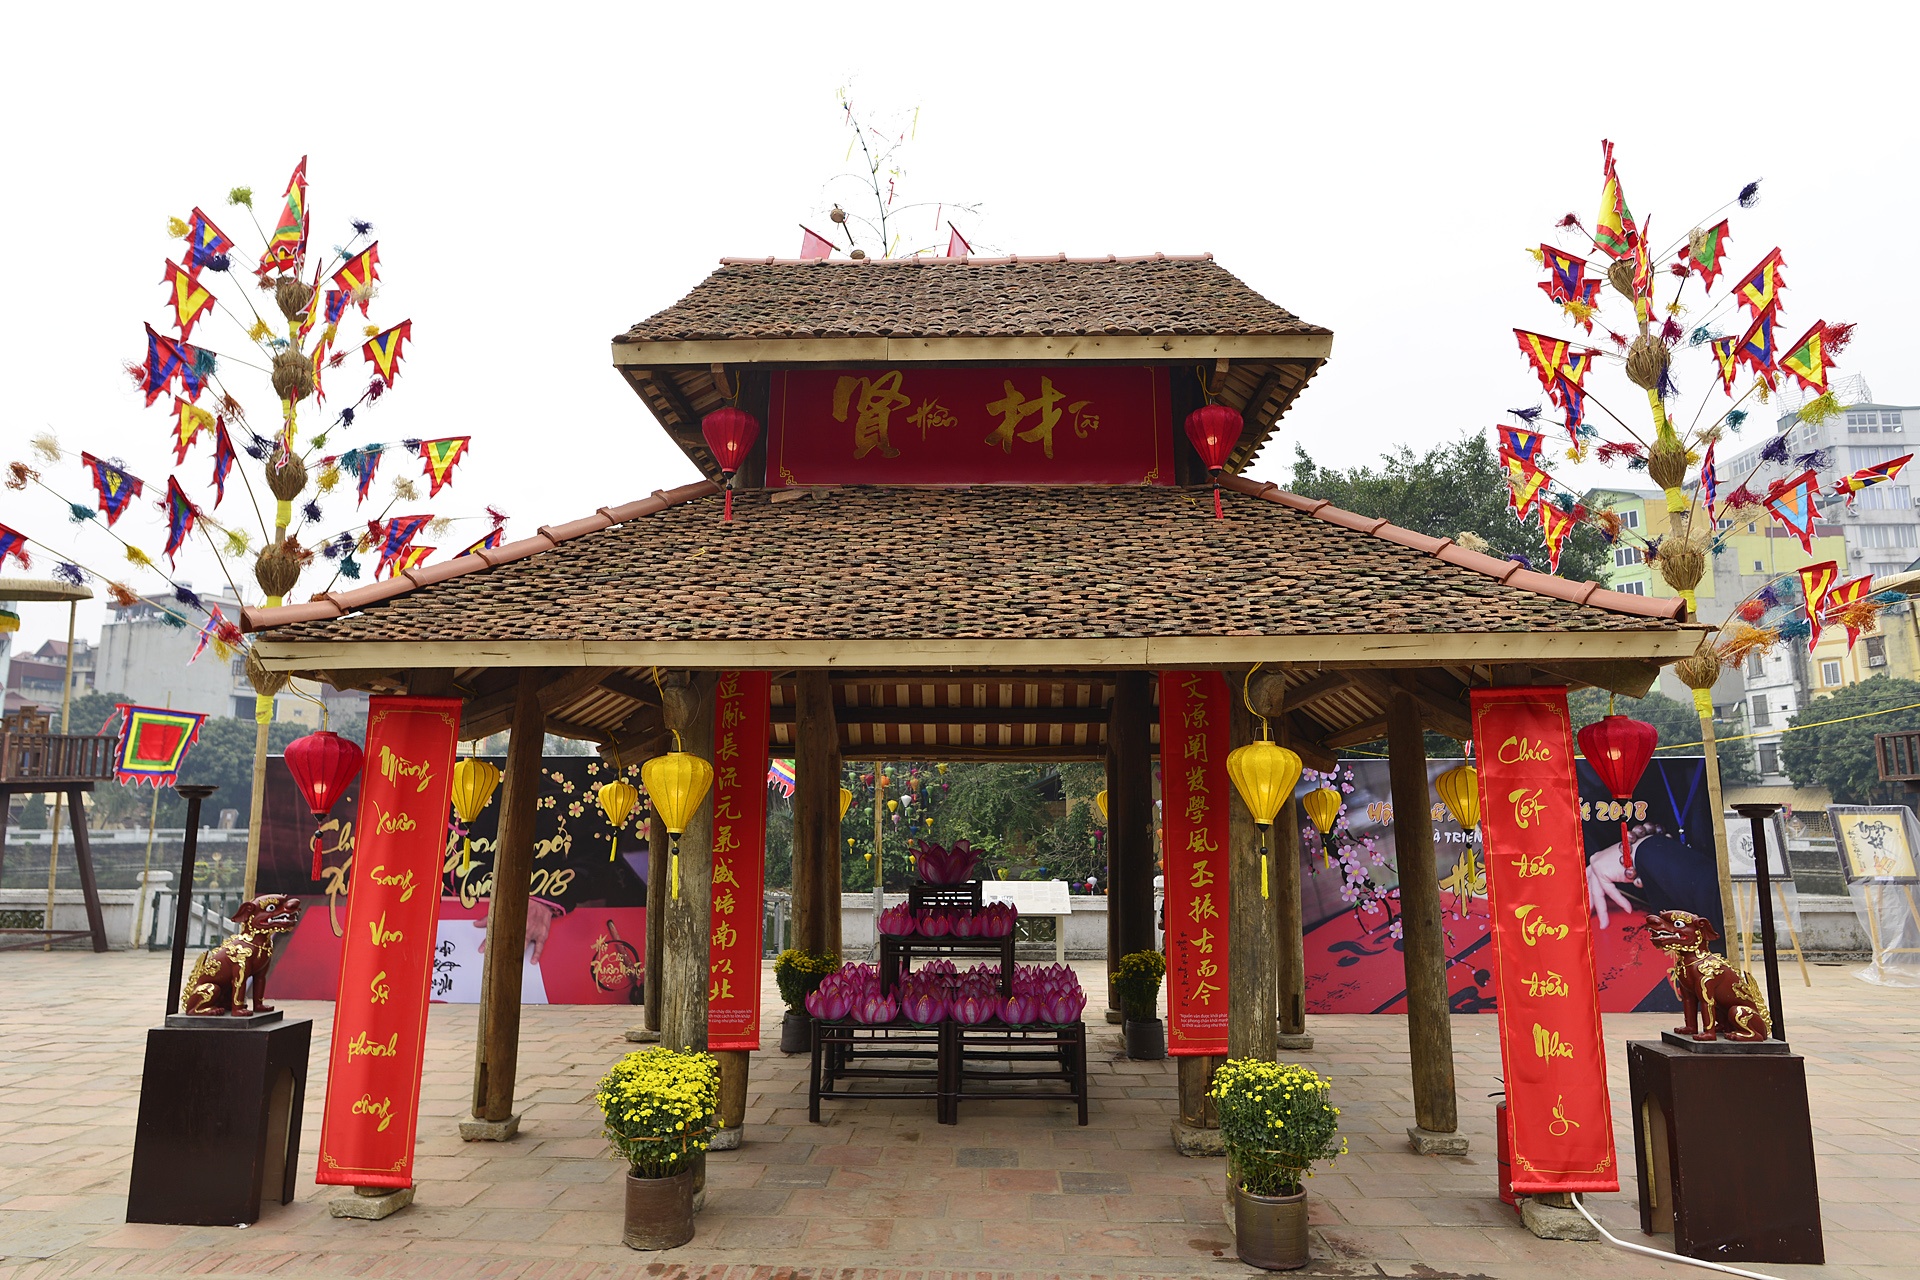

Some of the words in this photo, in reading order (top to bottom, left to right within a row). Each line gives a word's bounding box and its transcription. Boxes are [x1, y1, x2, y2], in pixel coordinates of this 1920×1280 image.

[1498, 735, 1553, 764] Chúc
[379, 745, 436, 793] Mừng
[373, 800, 417, 835] Xuân
[1366, 801, 1394, 826] Hộ
[1508, 788, 1547, 829] Tết
[1595, 800, 1648, 822] 2018
[529, 868, 576, 897] 018
[369, 911, 404, 949] Vạn
[370, 970, 390, 1005] Sự
